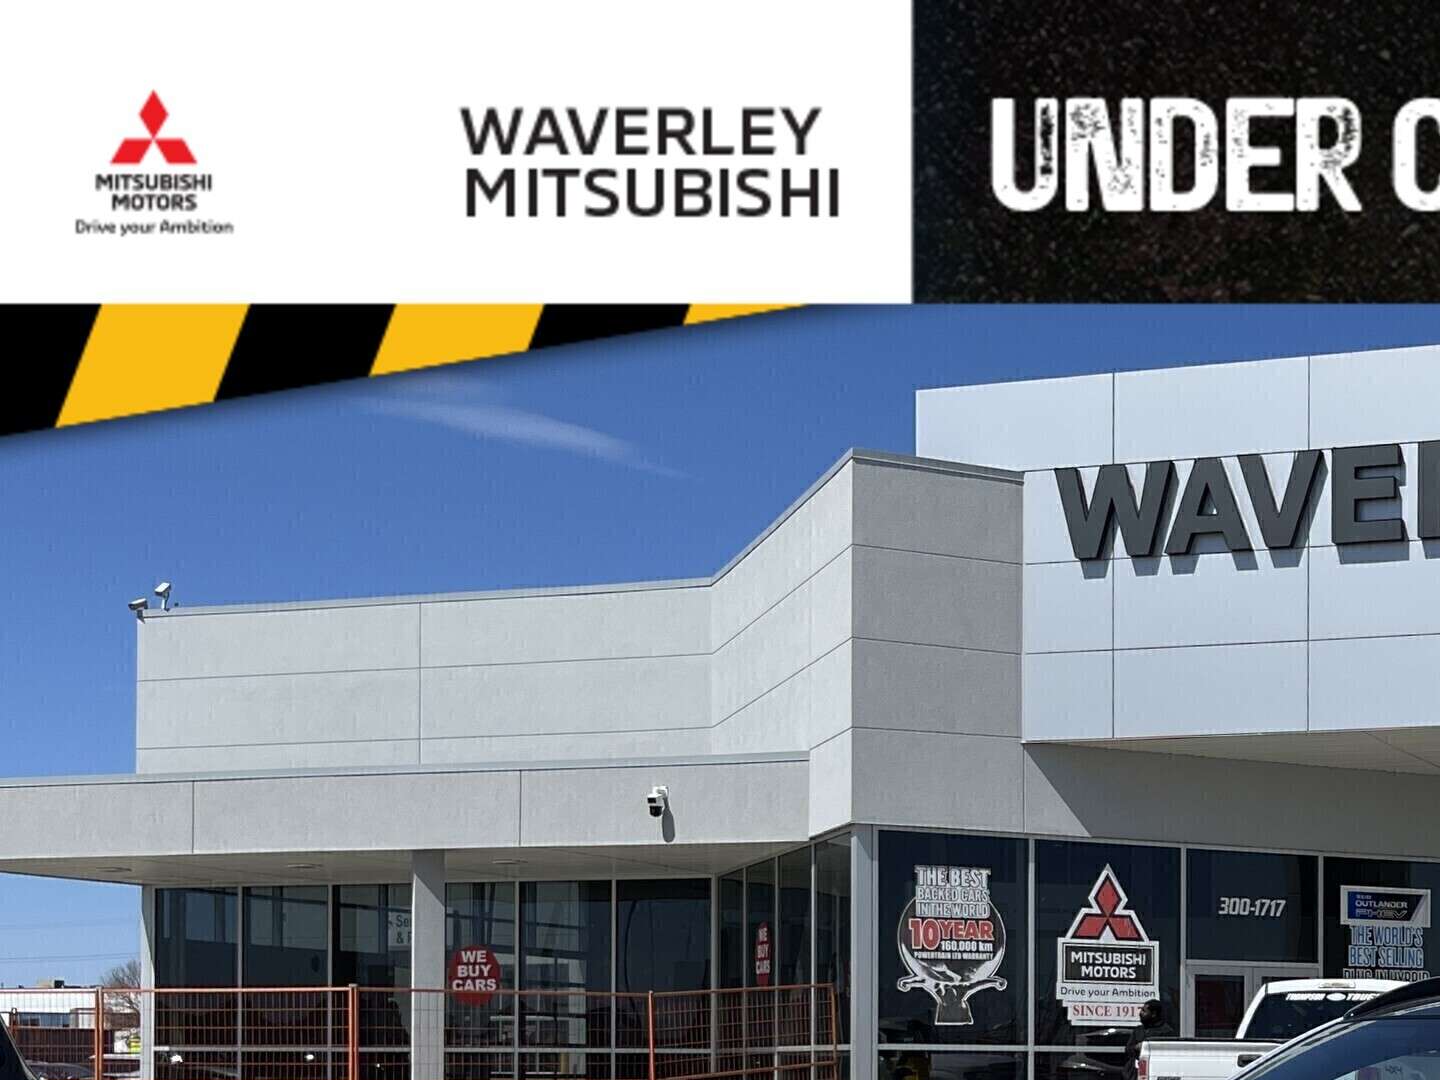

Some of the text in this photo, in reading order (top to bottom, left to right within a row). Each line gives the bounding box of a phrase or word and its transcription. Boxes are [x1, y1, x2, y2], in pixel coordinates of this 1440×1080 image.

[915, 865, 991, 888] THE BEST
[916, 887, 990, 901] BACKED CARS
[916, 902, 990, 918] IN THE WORLD
[1218, 897, 1286, 917] 300-1717
[1355, 900, 1408, 909] OUTLANDER
[909, 918, 940, 950] 10
[940, 920, 994, 941] YEAR
[1350, 926, 1423, 947] THE WORLD'S
[979, 941, 993, 951] km
[461, 950, 486, 963] WE
[1071, 951, 1146, 965] MITSUBISHI
[1348, 945, 1424, 968] BEST SELLING
[457, 965, 492, 978] BUY
[1081, 966, 1136, 978] MOTORS
[452, 979, 497, 991] CARS
[1061, 987, 1155, 998] Drive your Ambition
[1073, 1005, 1112, 1017] SINCE
